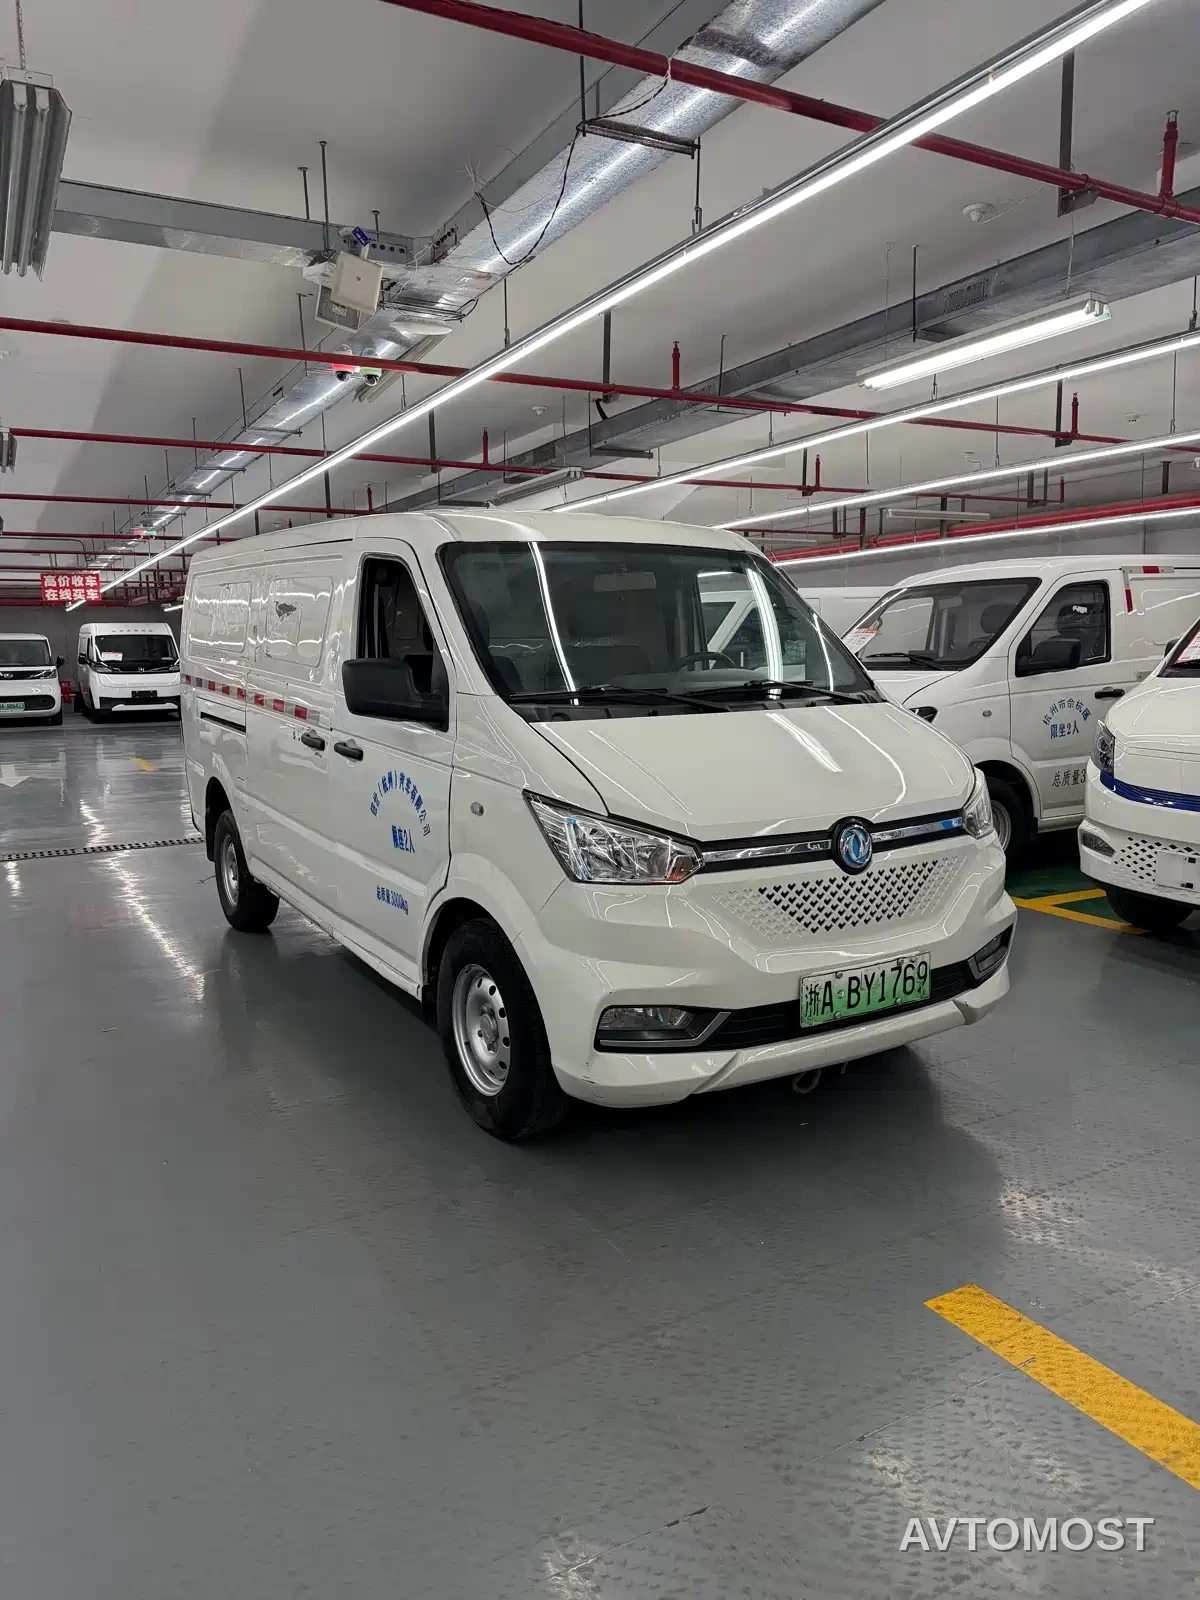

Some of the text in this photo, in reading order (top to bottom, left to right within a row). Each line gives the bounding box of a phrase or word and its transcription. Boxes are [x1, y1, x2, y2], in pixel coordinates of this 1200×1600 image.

[43, 575, 98, 587] 高价收车
[44, 588, 99, 600] 在线买车
[1050, 720, 1080, 740] 限坐2人
[391, 824, 416, 854] 限座2人
